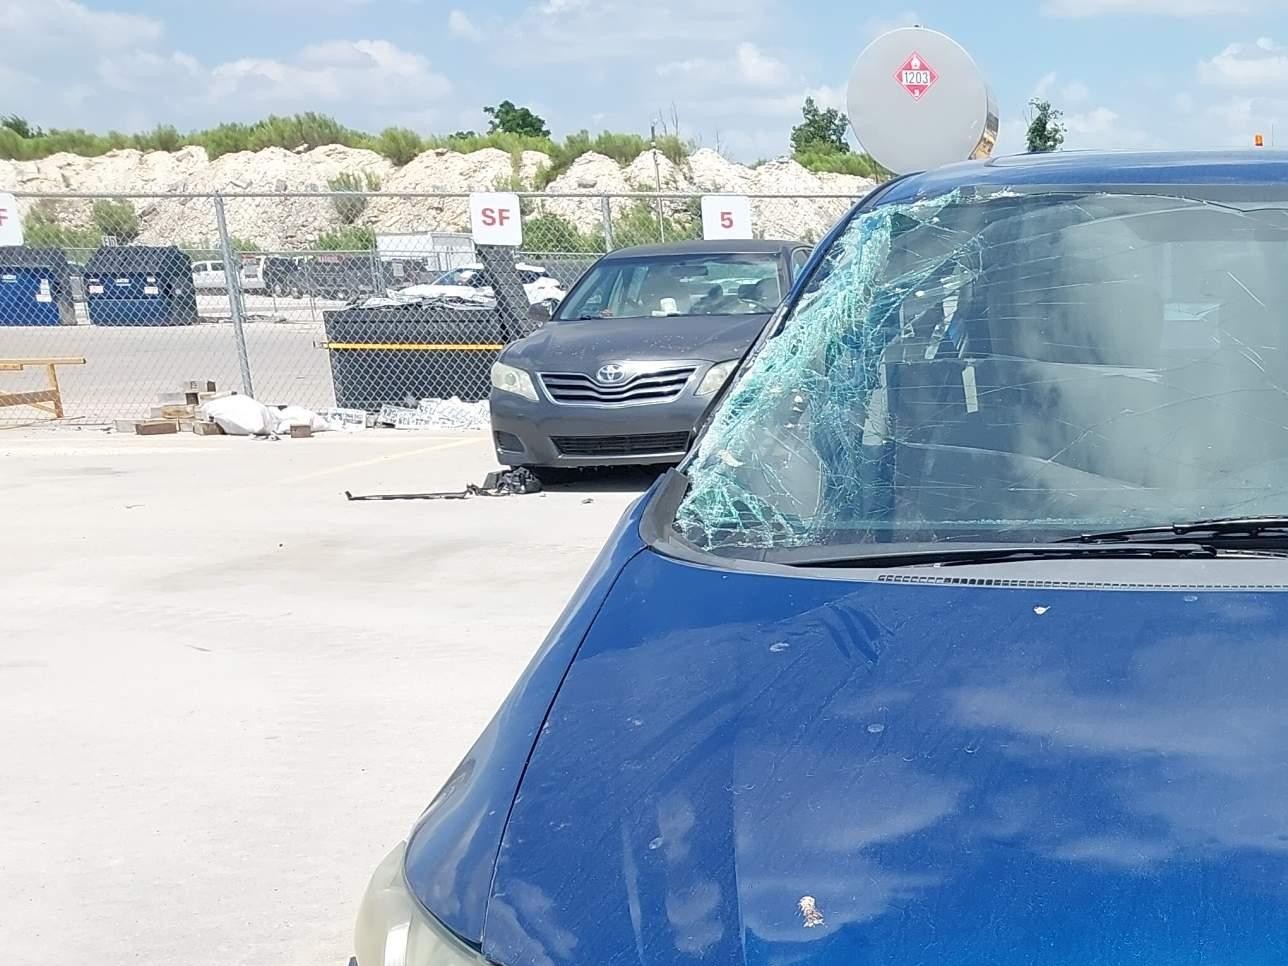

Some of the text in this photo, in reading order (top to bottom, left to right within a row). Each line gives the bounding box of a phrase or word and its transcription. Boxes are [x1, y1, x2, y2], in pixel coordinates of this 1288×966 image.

[904, 71, 928, 84] 1203
[481, 207, 510, 226] SF
[720, 211, 734, 229] 5
